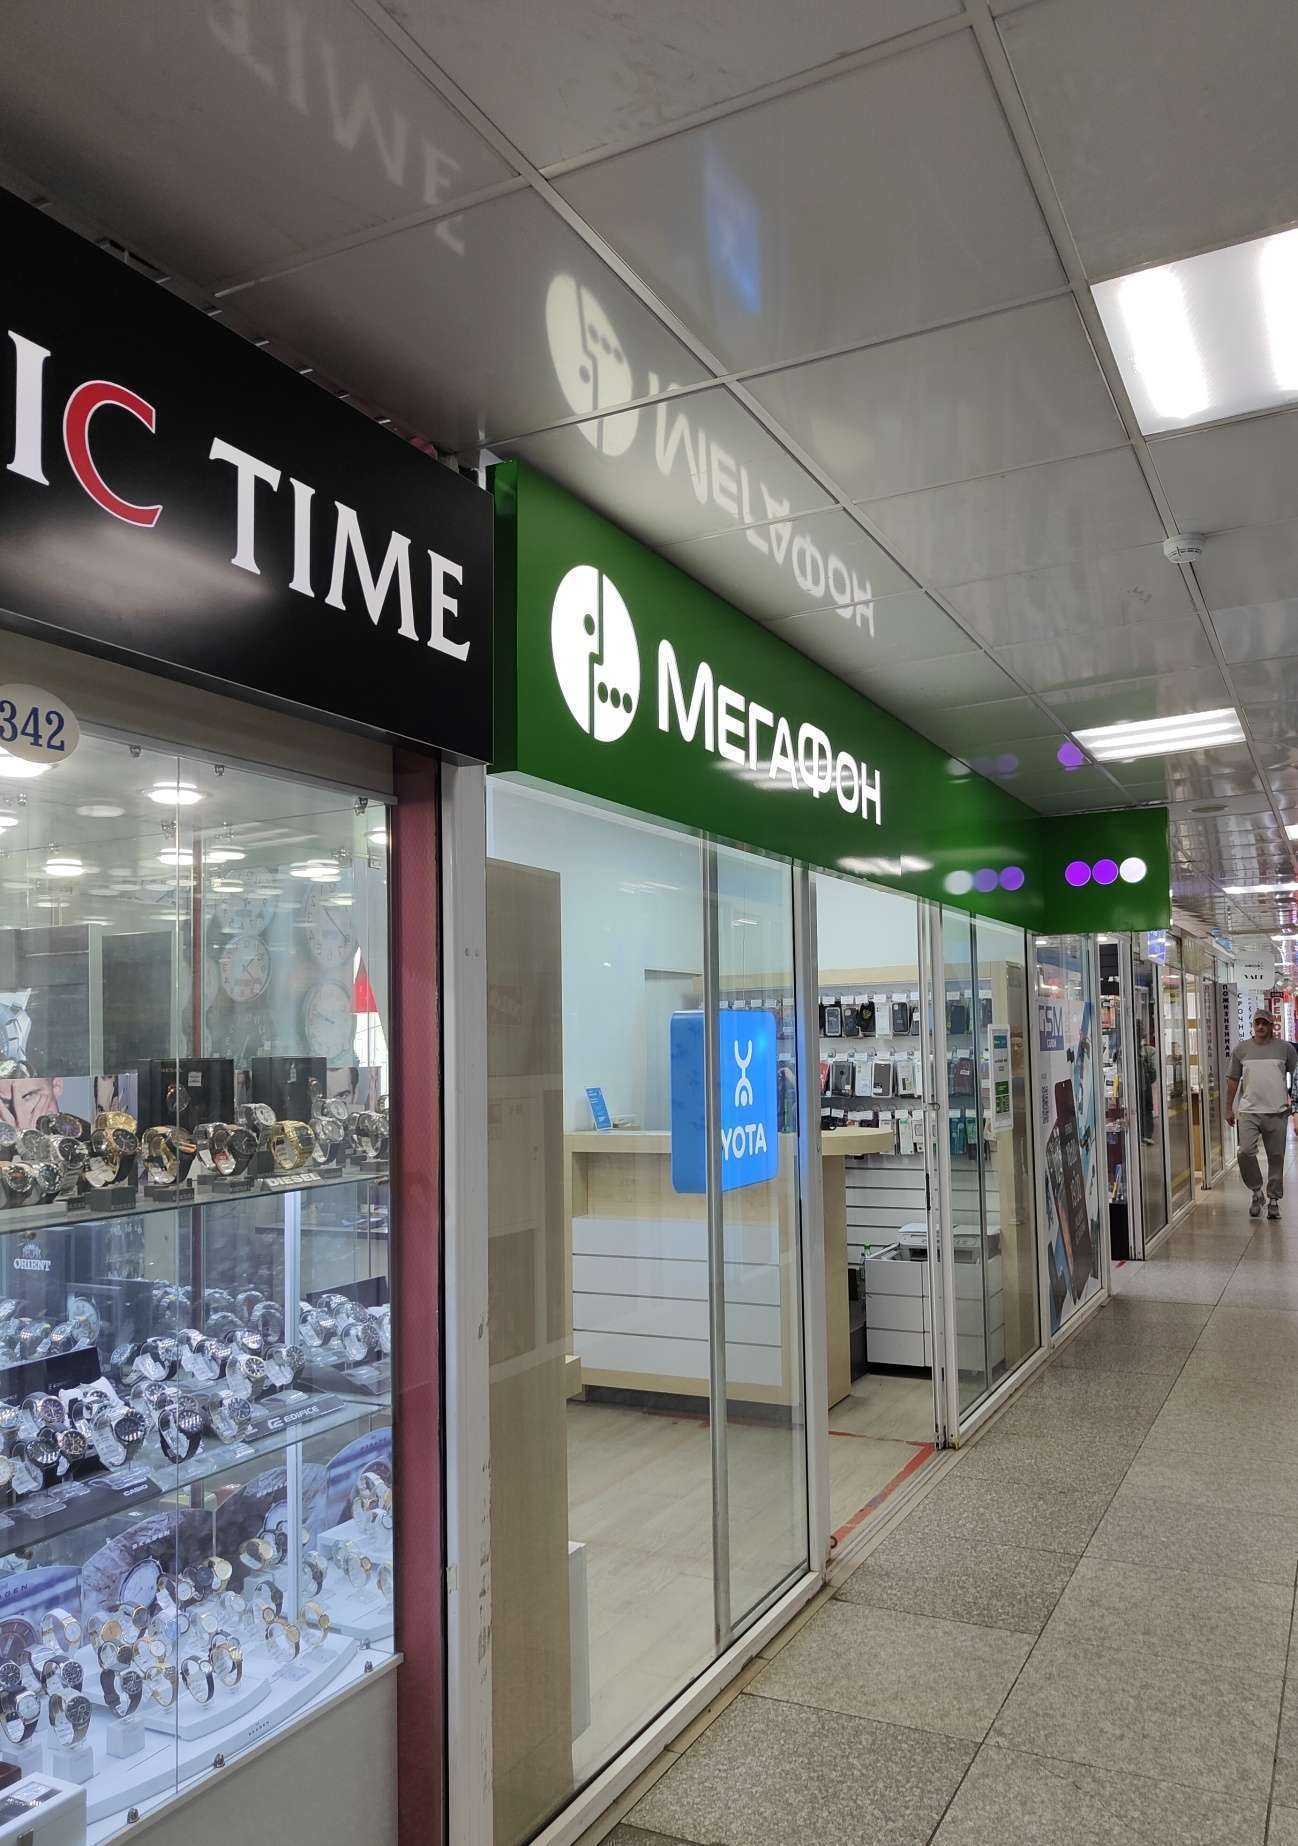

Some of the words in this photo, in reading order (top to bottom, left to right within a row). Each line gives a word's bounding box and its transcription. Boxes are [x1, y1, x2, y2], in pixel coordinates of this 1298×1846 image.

[6, 329, 164, 528] IC
[208, 437, 471, 662] TIME
[0, 700, 65, 751] 342
[657, 638, 882, 826] МЕГАФОН
[1237, 992, 1245, 1041] СРОЧНЫ
[721, 1122, 768, 1161] YOTA
[265, 1171, 321, 1187] DIESEL
[13, 1258, 52, 1272] ORIENT
[283, 1405, 320, 1423] EDIFICE
